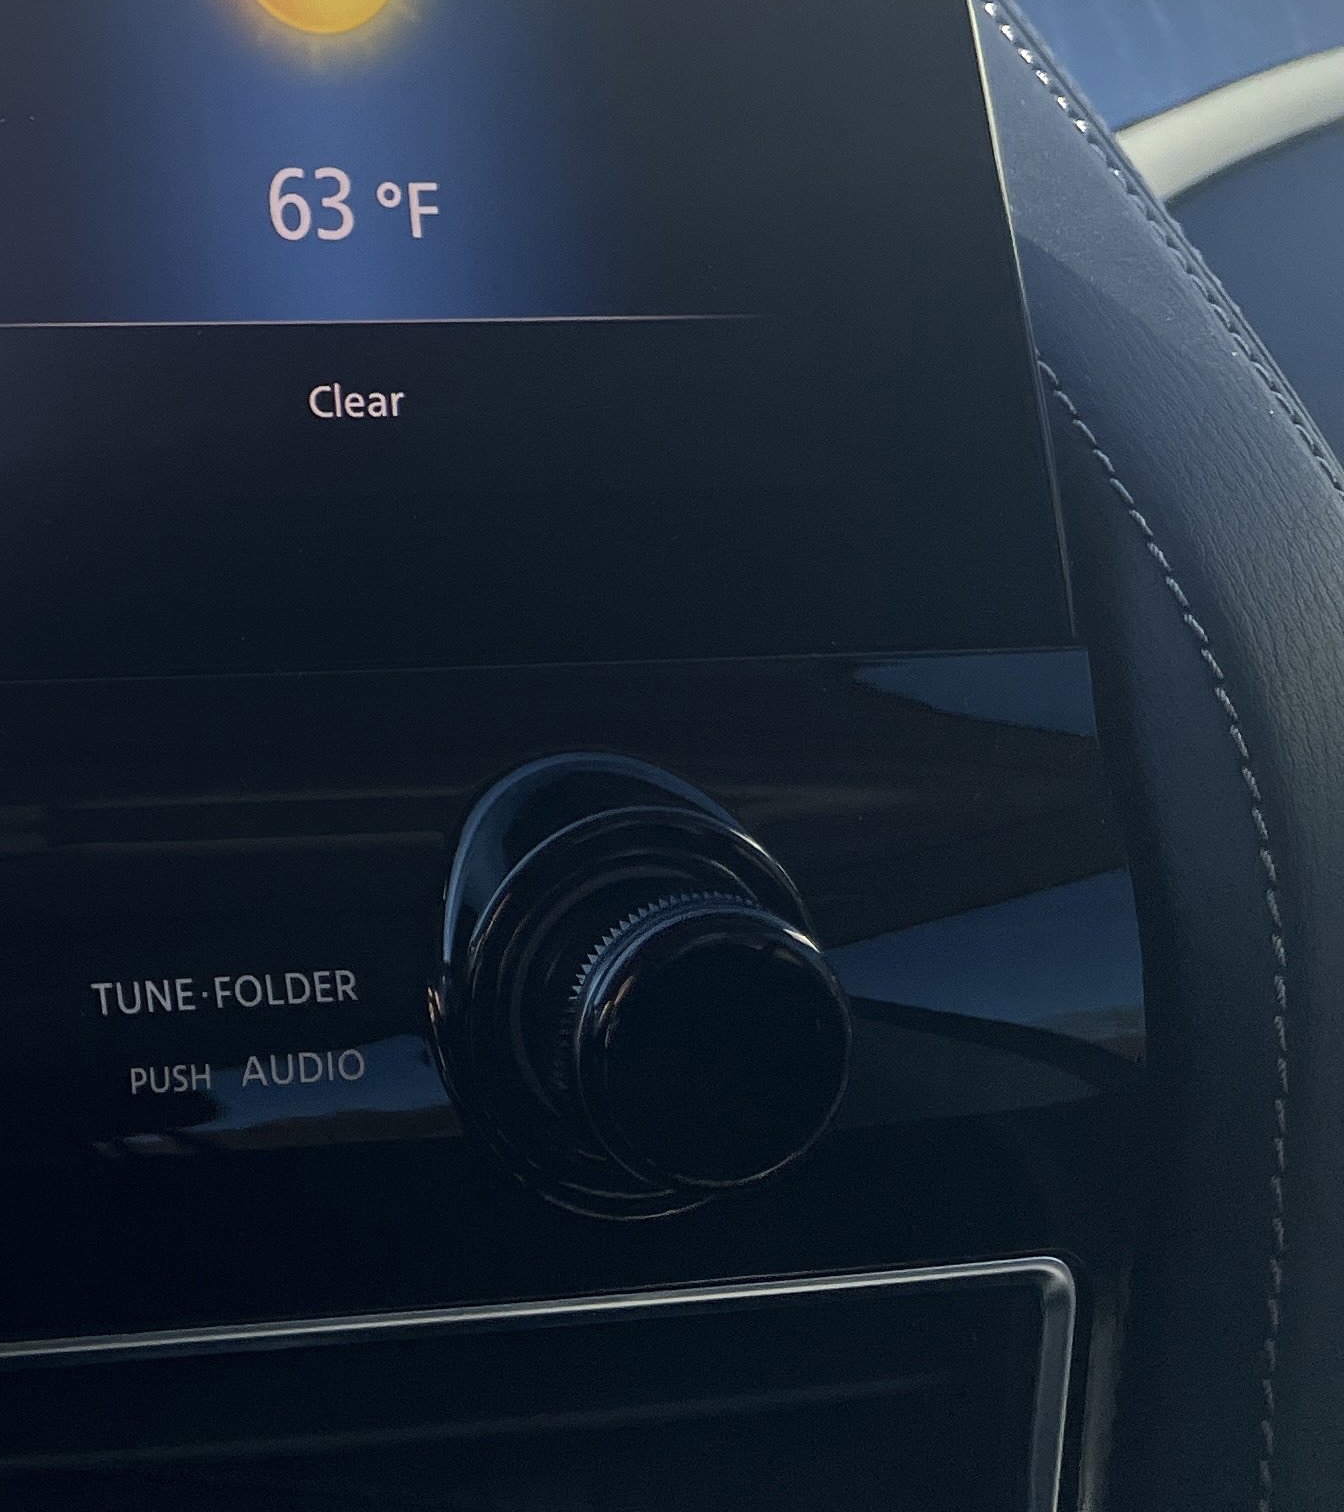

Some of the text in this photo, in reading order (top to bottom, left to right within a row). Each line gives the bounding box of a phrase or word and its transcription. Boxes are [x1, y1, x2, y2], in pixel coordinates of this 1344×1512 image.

[269, 166, 355, 241] 63
[309, 382, 405, 418] Clear
[130, 1048, 367, 1095] PUSH AUDIO
